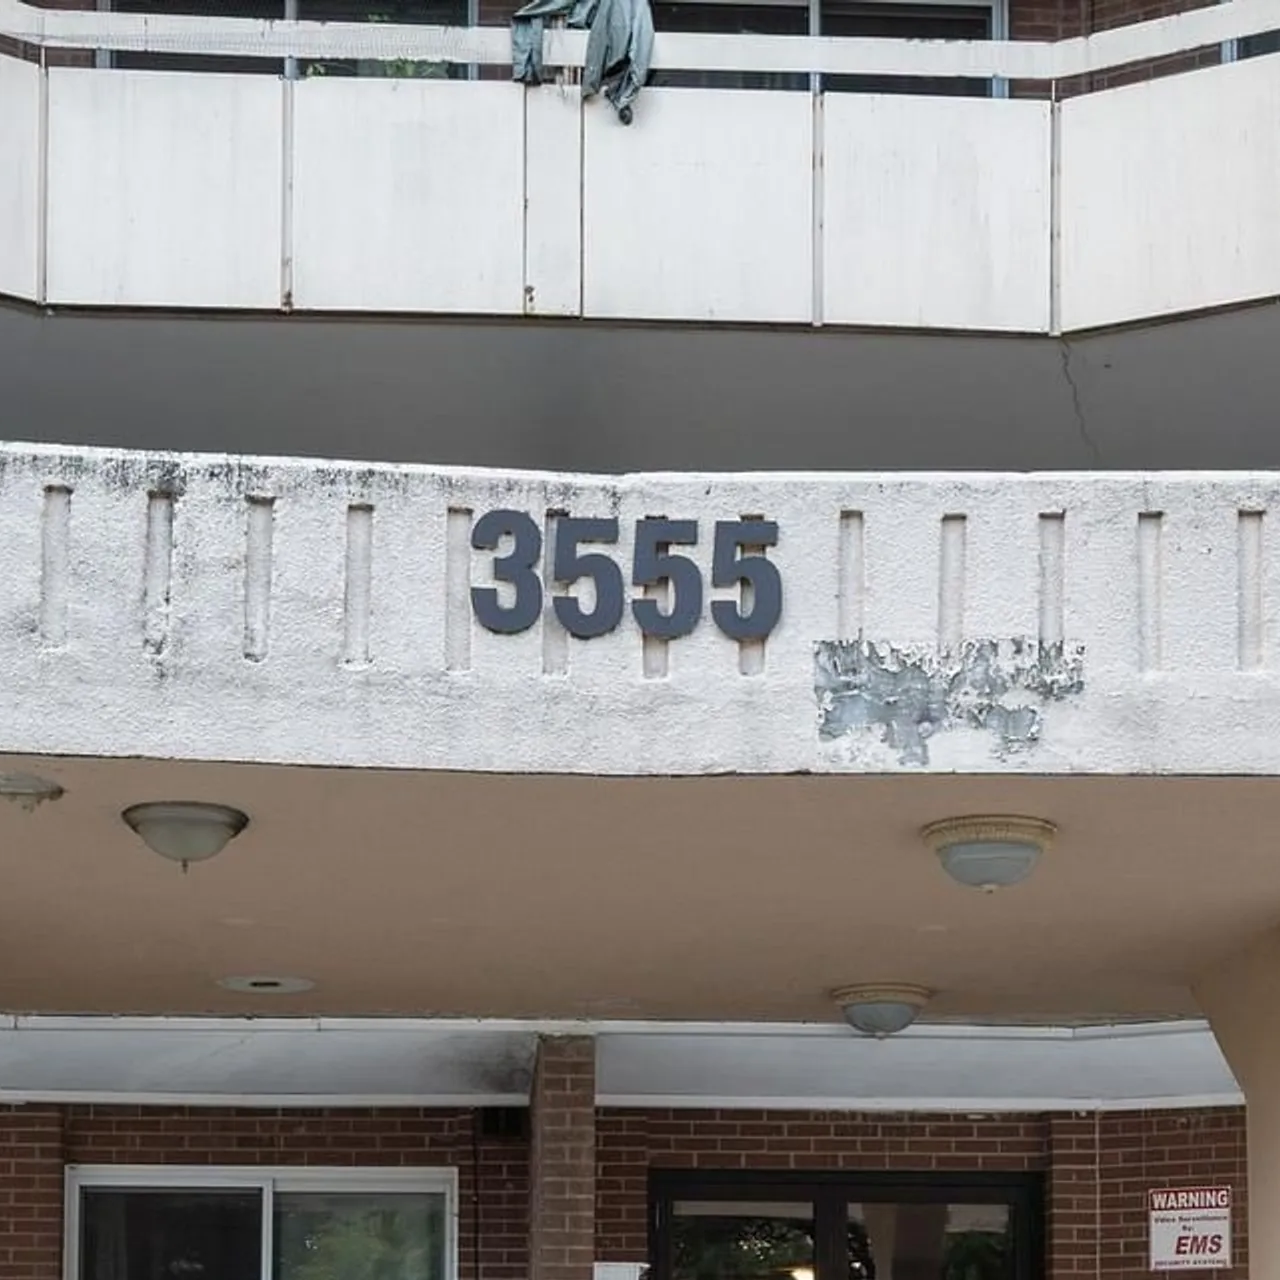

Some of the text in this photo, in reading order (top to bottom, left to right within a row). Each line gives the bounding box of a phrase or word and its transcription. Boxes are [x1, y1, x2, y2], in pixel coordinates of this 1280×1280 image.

[470, 508, 783, 641] 3555
[1152, 1189, 1228, 1210] WARNING
[1175, 1234, 1223, 1256] EMS
